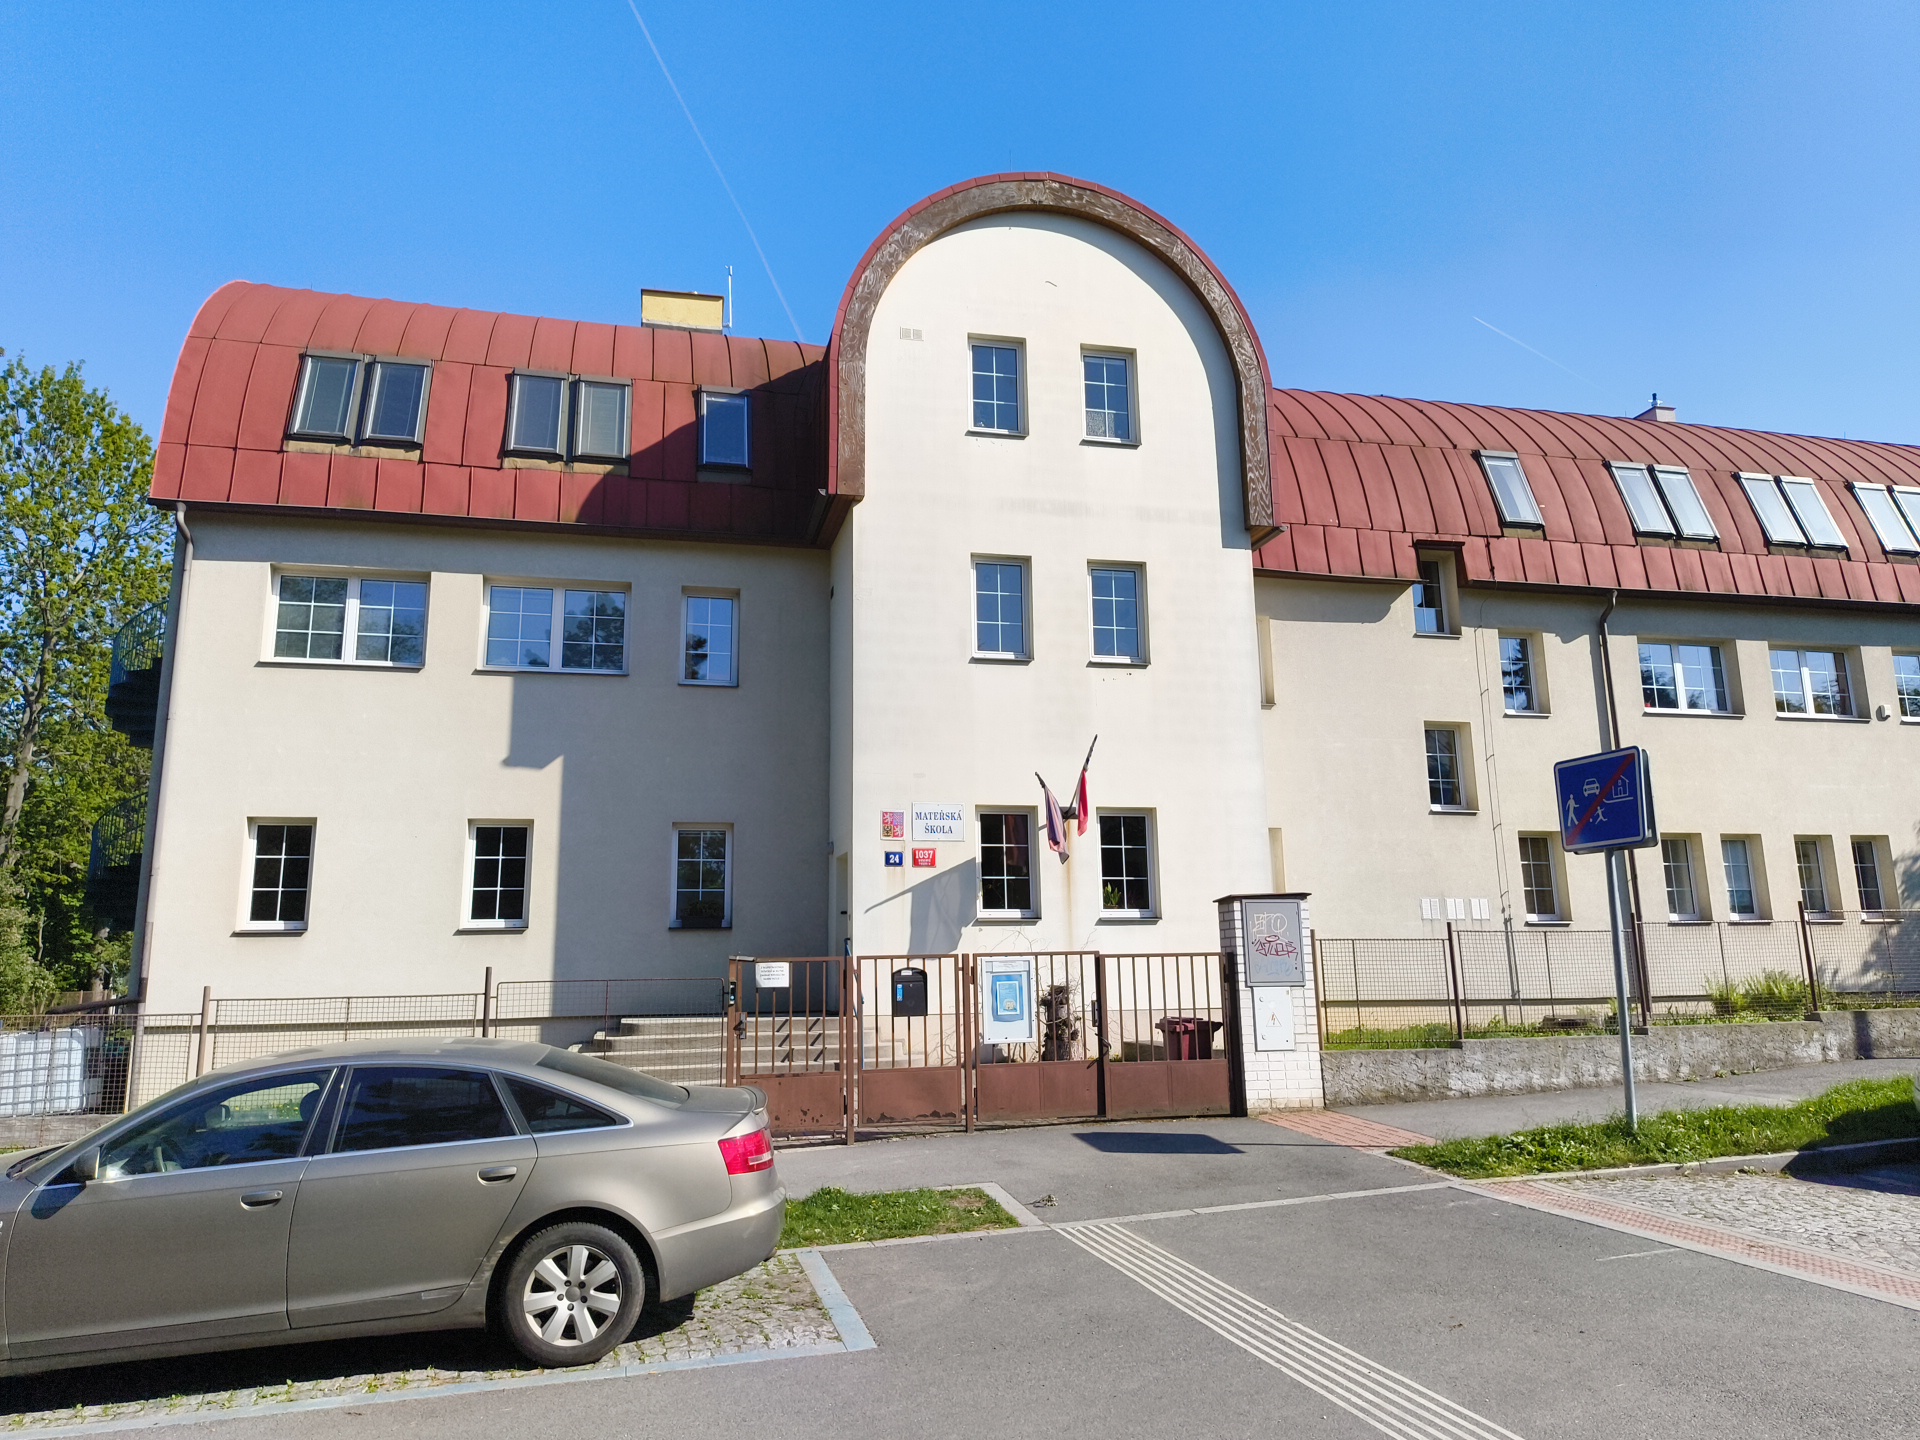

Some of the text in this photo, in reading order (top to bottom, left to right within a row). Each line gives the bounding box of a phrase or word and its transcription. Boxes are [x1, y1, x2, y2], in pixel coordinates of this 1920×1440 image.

[915, 810, 962, 820] MATEŘSKÁ
[924, 823, 953, 834] ŠKOLA
[889, 854, 900, 863] 24
[915, 850, 934, 859] 1037
